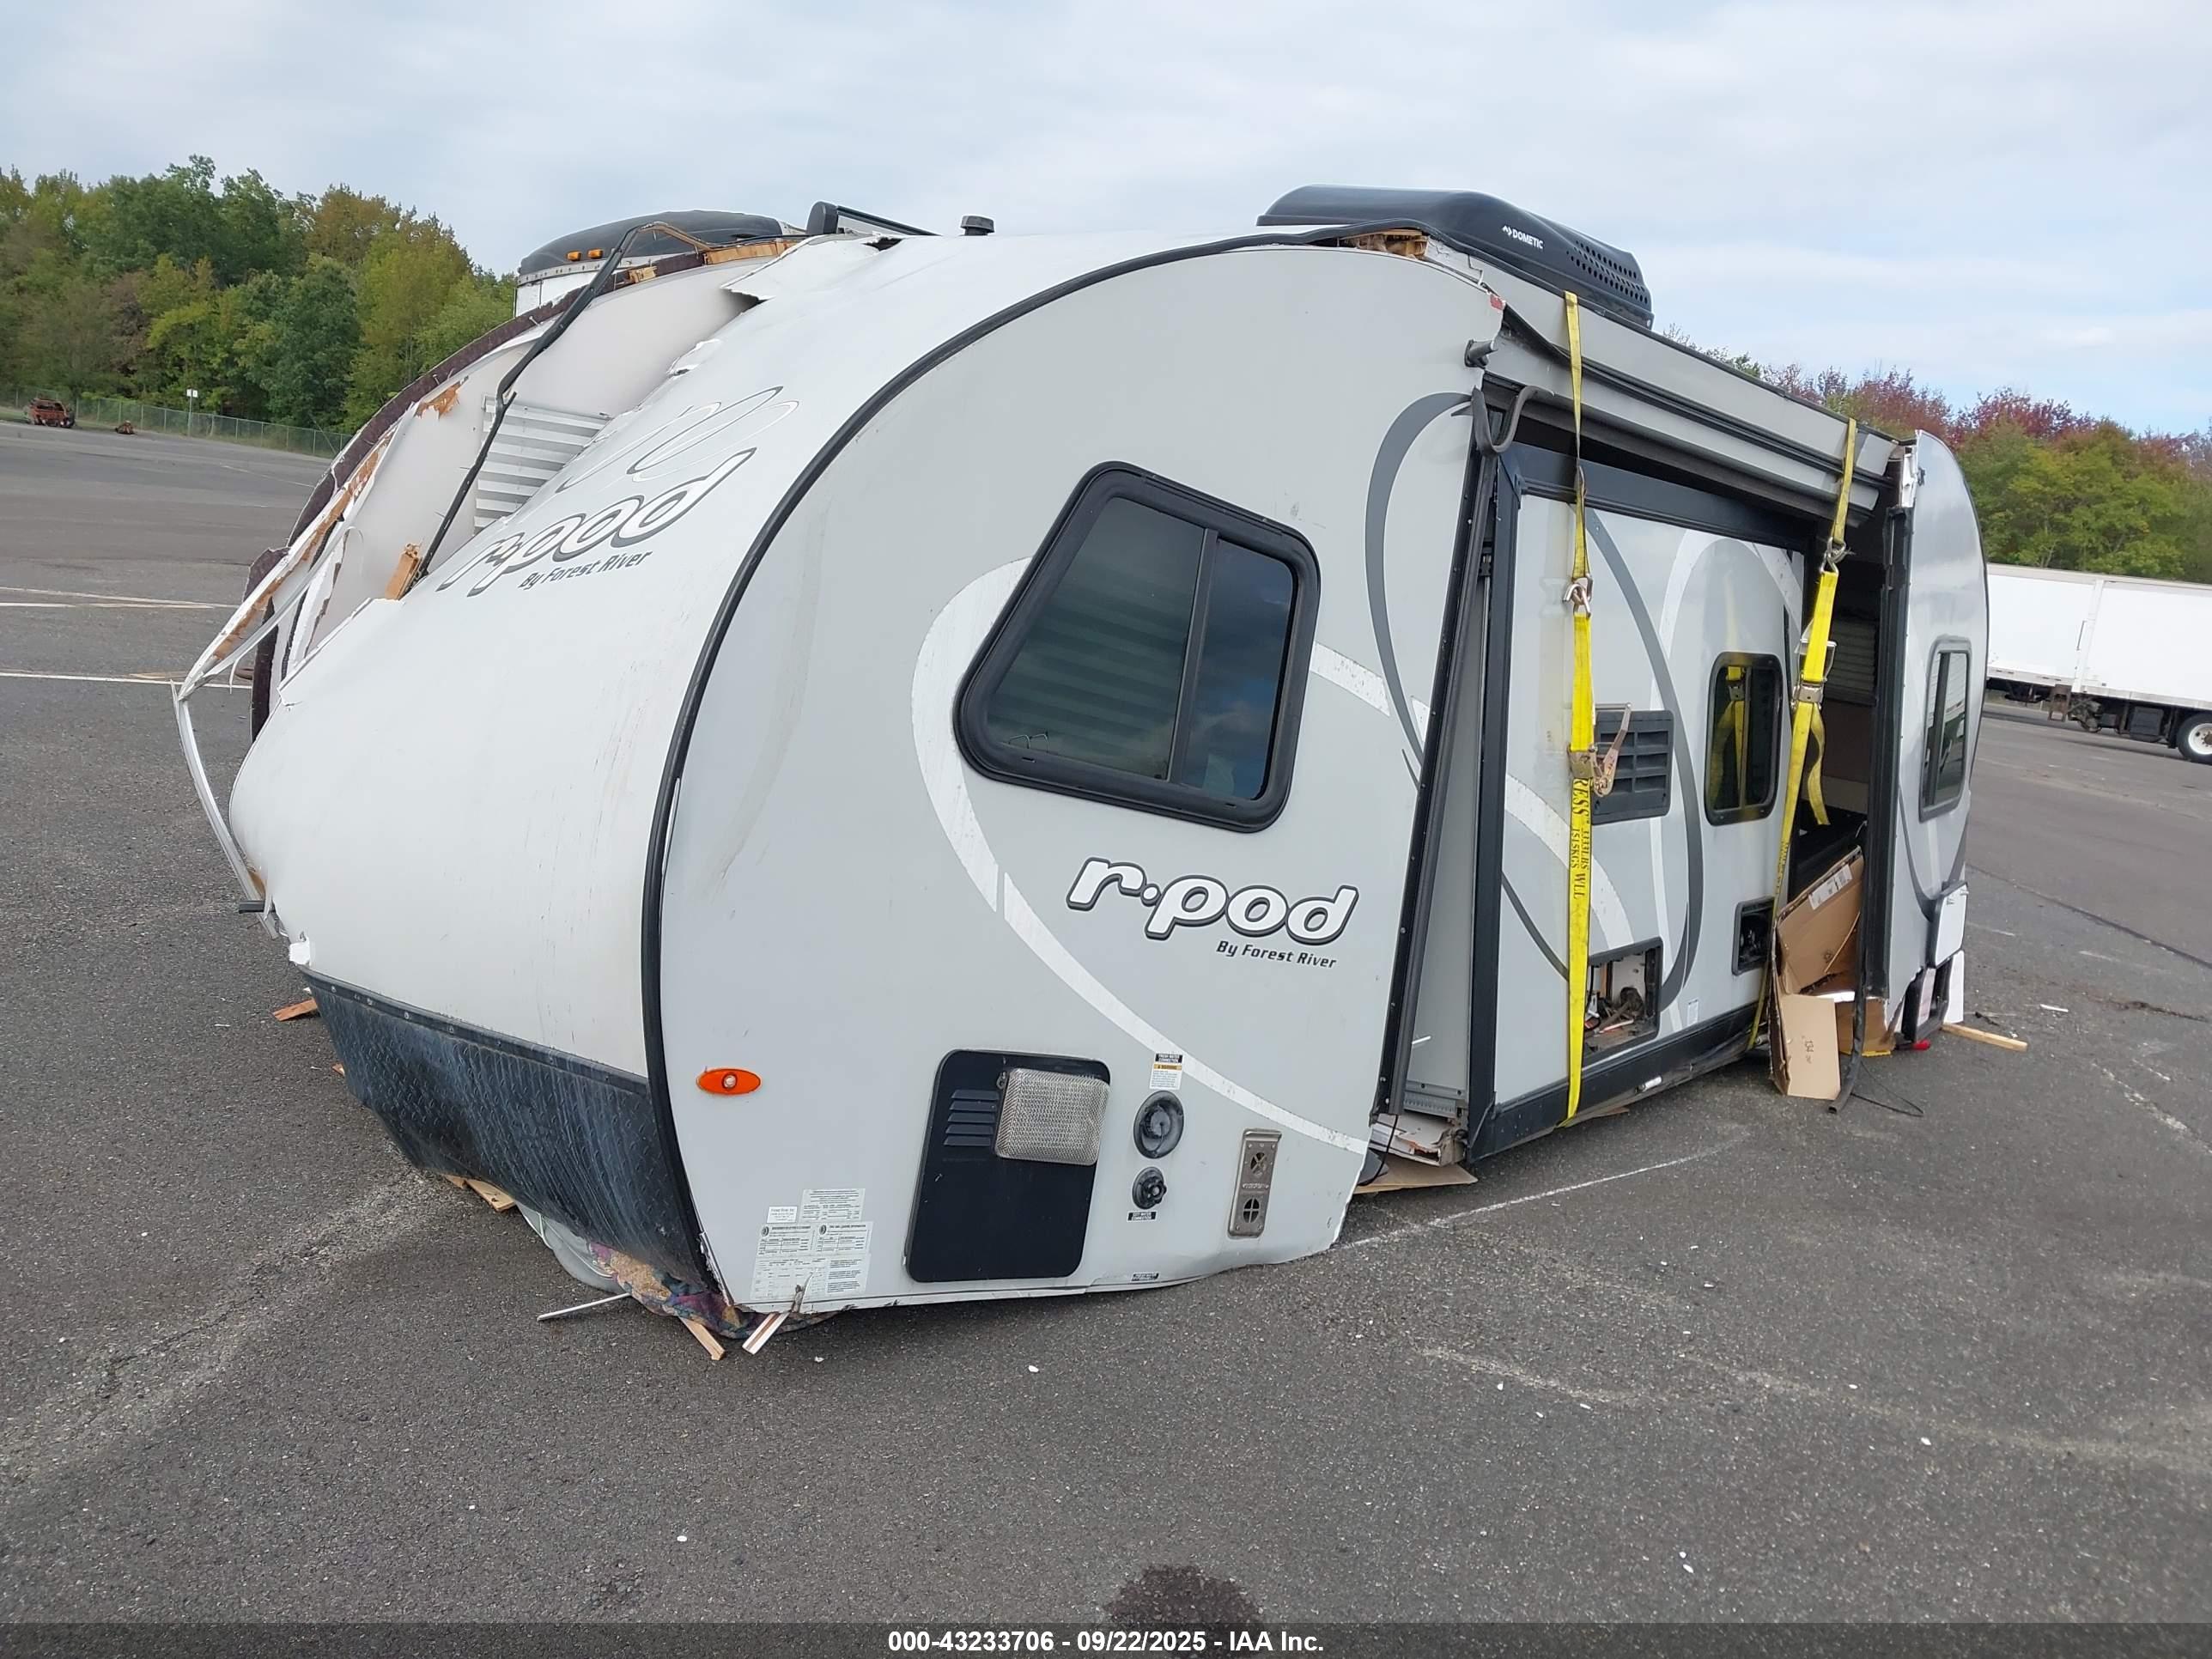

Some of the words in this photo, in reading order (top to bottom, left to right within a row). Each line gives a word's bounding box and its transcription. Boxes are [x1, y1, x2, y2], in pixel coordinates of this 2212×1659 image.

[1512, 228, 1544, 249] DOMETIC
[518, 572, 544, 590] By
[540, 560, 601, 584] Forest
[598, 551, 653, 573] River
[1573, 872, 1586, 899] WLL
[1216, 940, 1238, 957] By
[1242, 945, 1293, 962] Forest
[1297, 952, 1337, 968] River
